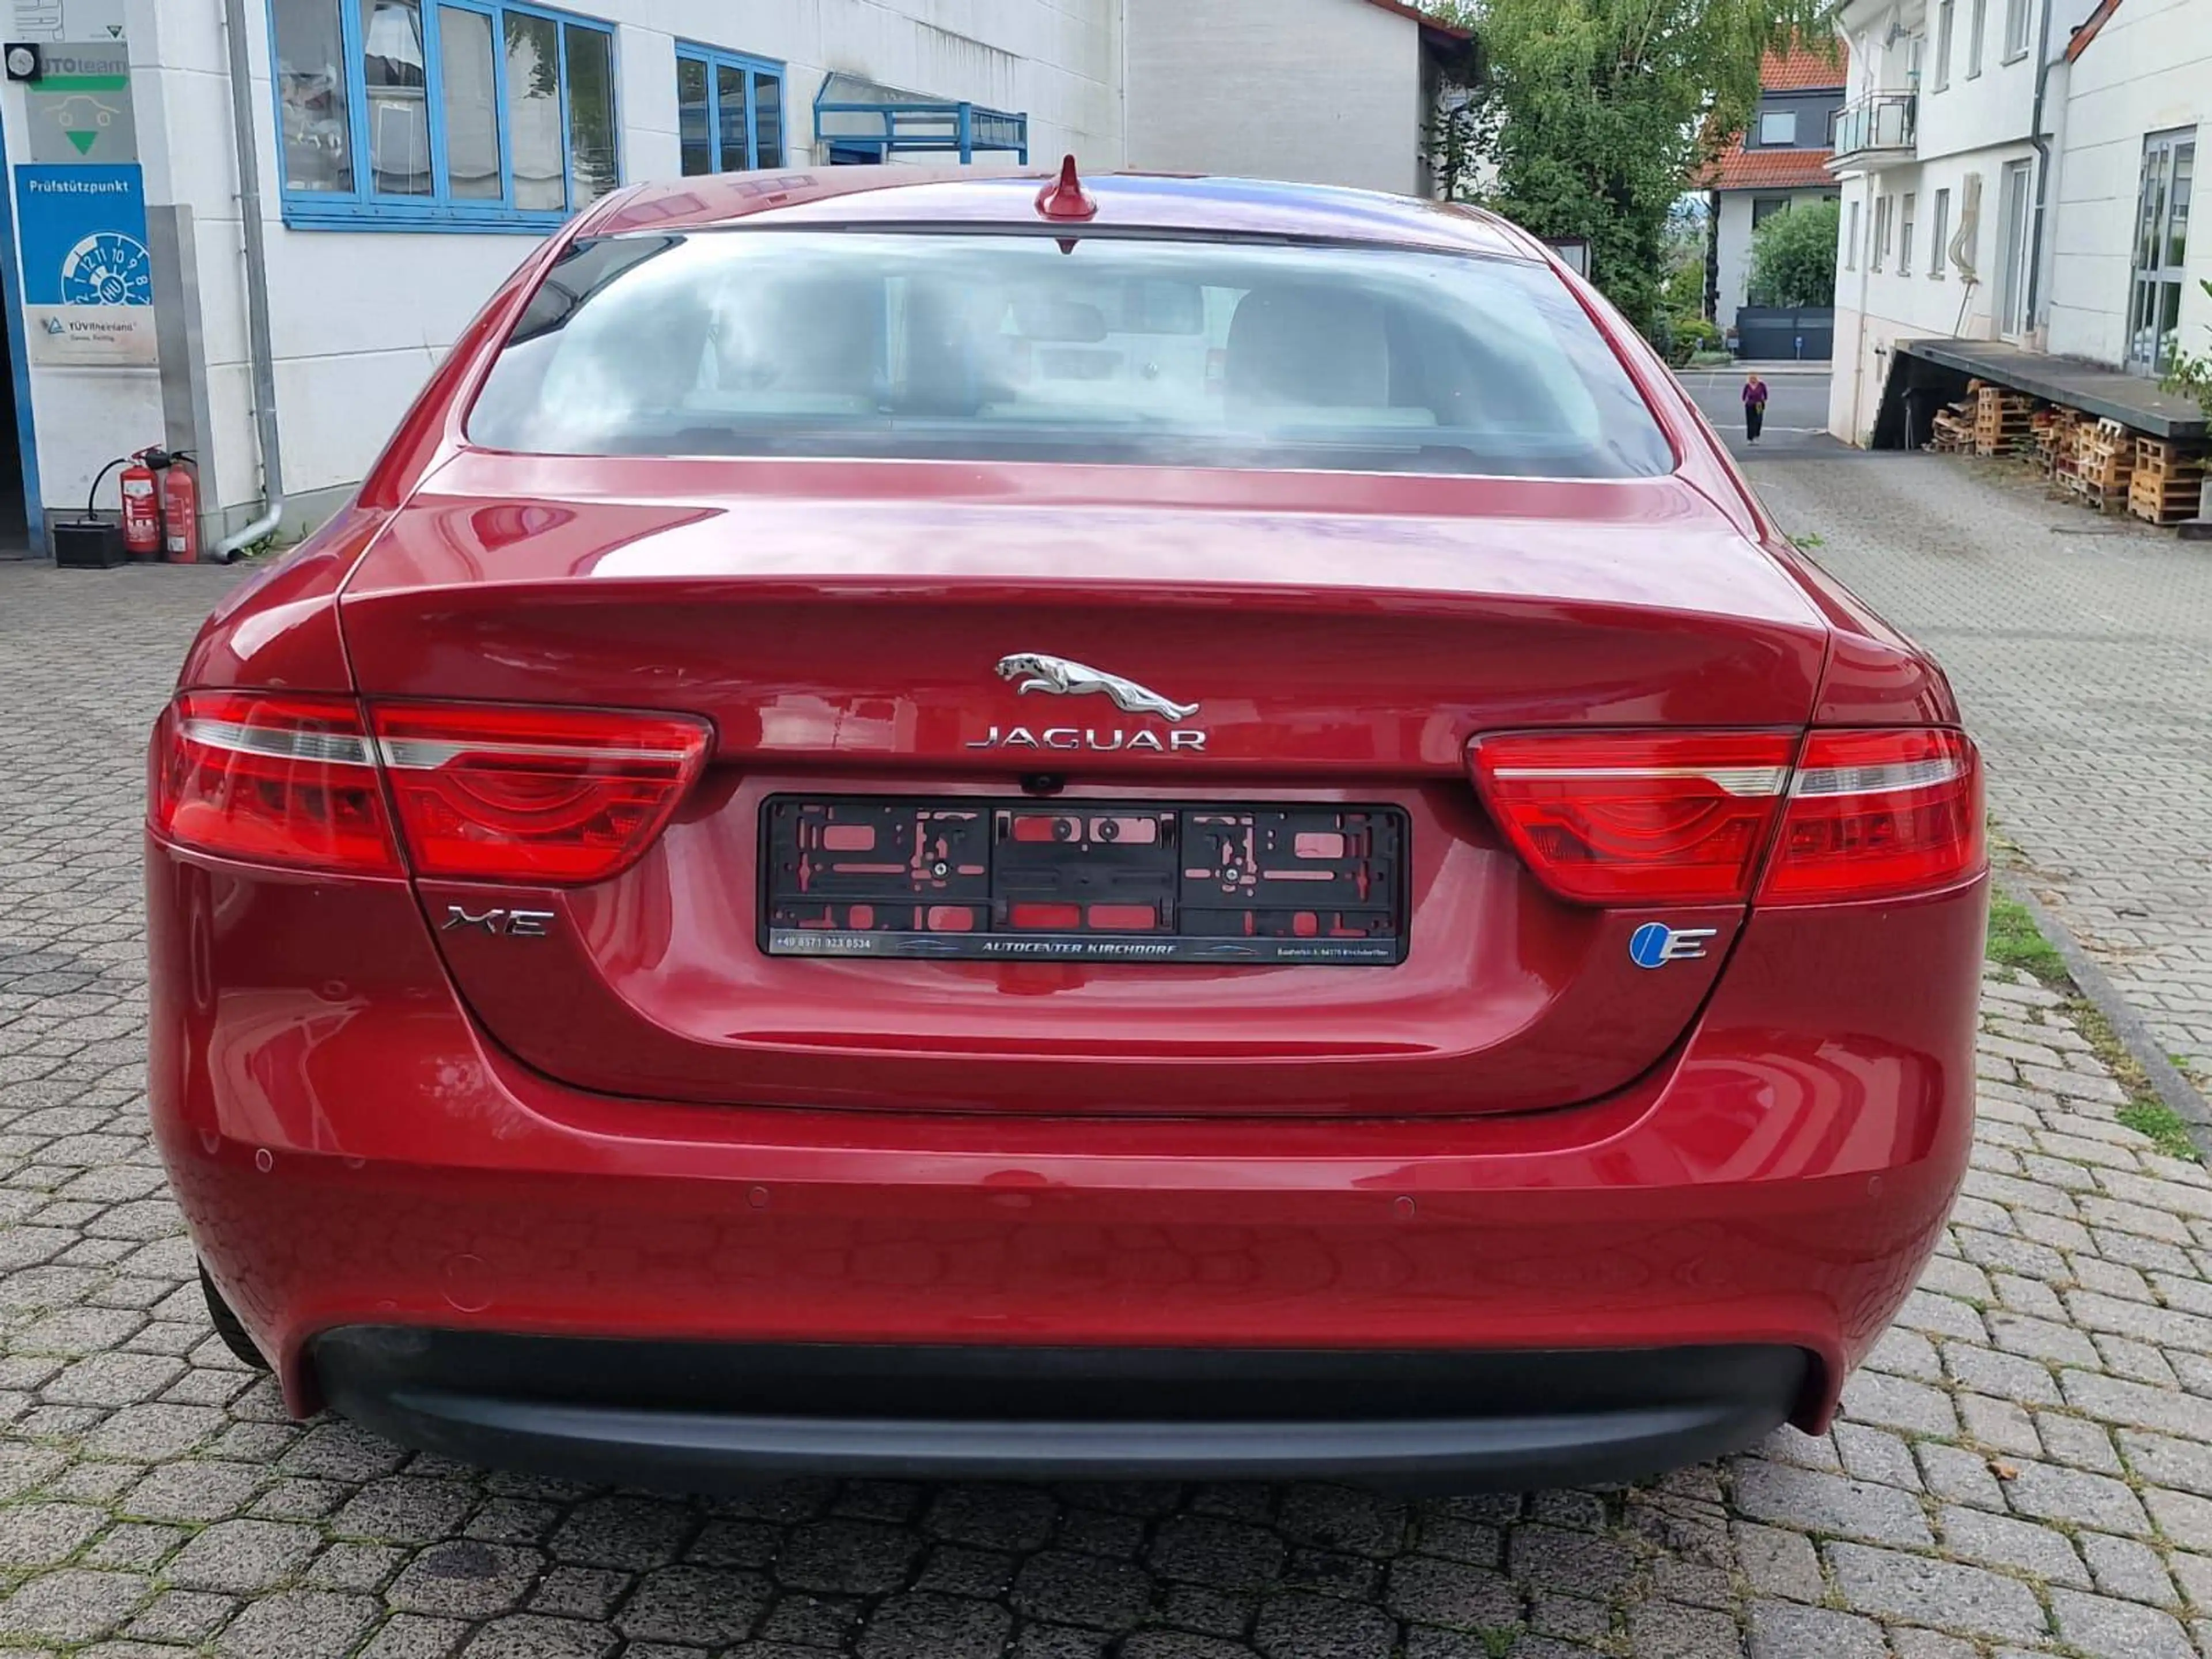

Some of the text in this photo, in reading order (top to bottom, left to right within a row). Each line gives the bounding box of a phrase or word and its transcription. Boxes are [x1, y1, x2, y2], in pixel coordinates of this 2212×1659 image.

[42, 58, 127, 73] UTOteam
[29, 180, 130, 193] Prüfstützpunkt
[94, 248, 107, 263] 11
[112, 248, 124, 263] 10
[79, 256, 96, 272] 12
[127, 259, 138, 270] 9
[135, 275, 149, 286] 8
[102, 279, 122, 301] HU
[76, 293, 89, 304] 2
[138, 295, 150, 305] 7
[965, 726, 1207, 752] JAGUAR
[441, 905, 554, 935] XE
[982, 942, 1179, 955] AUTOCENTER KIRCHDORF
